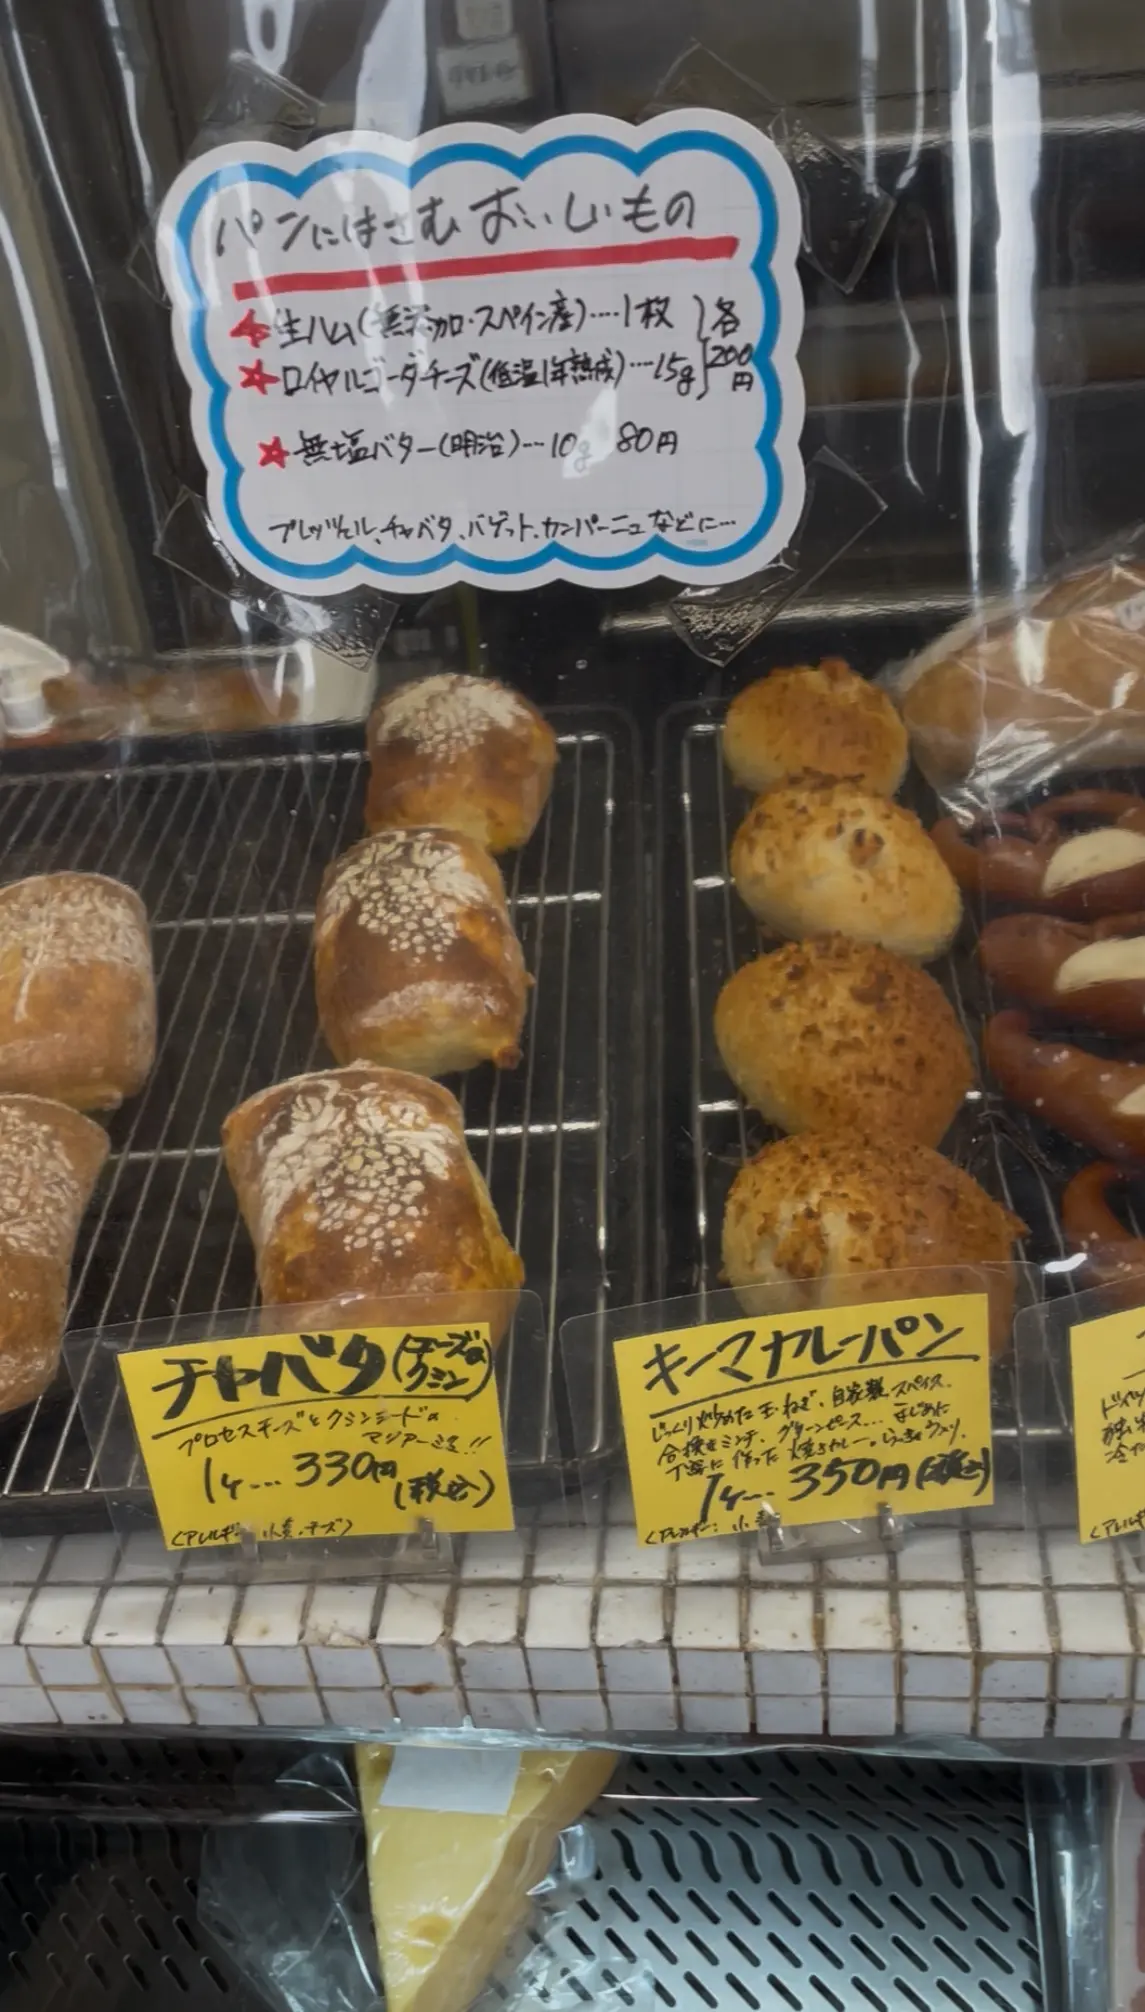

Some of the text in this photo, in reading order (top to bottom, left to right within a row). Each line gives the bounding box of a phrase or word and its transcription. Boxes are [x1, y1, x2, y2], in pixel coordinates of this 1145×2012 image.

[616, 420, 678, 456] 80円
[643, 1312, 965, 1396] キーマカレーパン
